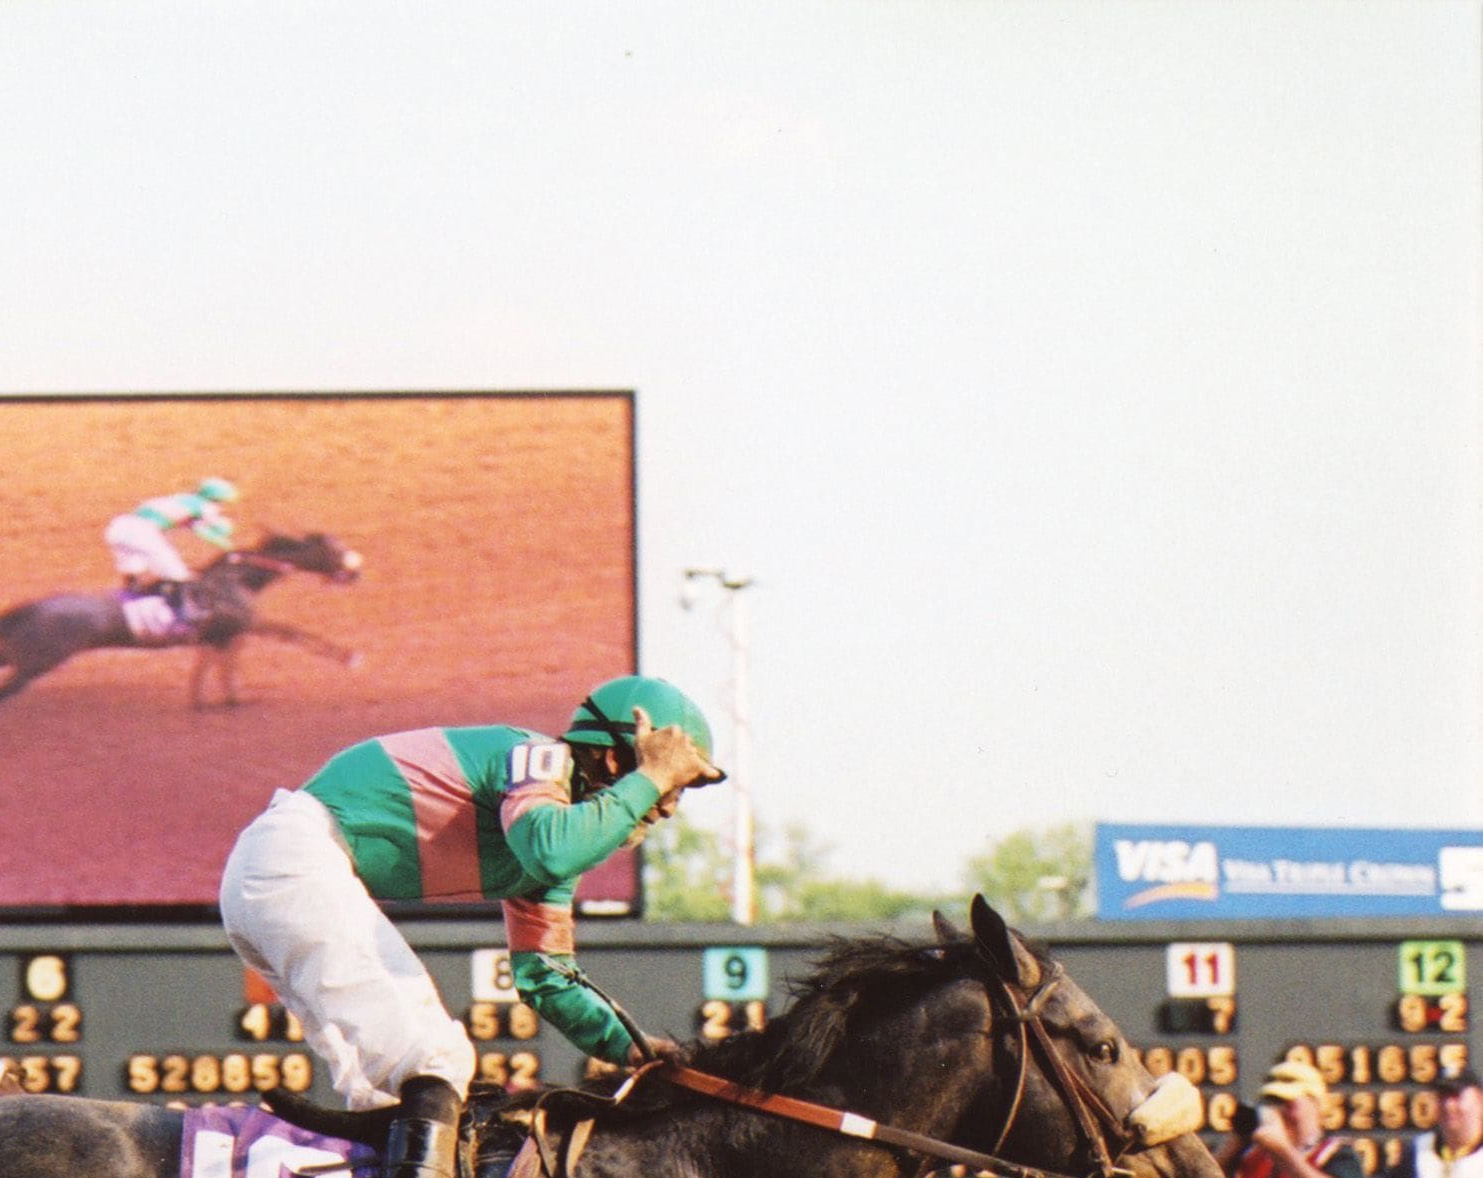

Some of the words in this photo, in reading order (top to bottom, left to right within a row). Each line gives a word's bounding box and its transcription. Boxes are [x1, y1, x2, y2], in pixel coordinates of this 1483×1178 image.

[511, 742, 572, 784] 10
[1115, 839, 1216, 883] VISA
[26, 954, 68, 1001] 6
[723, 955, 747, 991] 9
[1182, 952, 1219, 986] 11
[1413, 950, 1456, 983] 12
